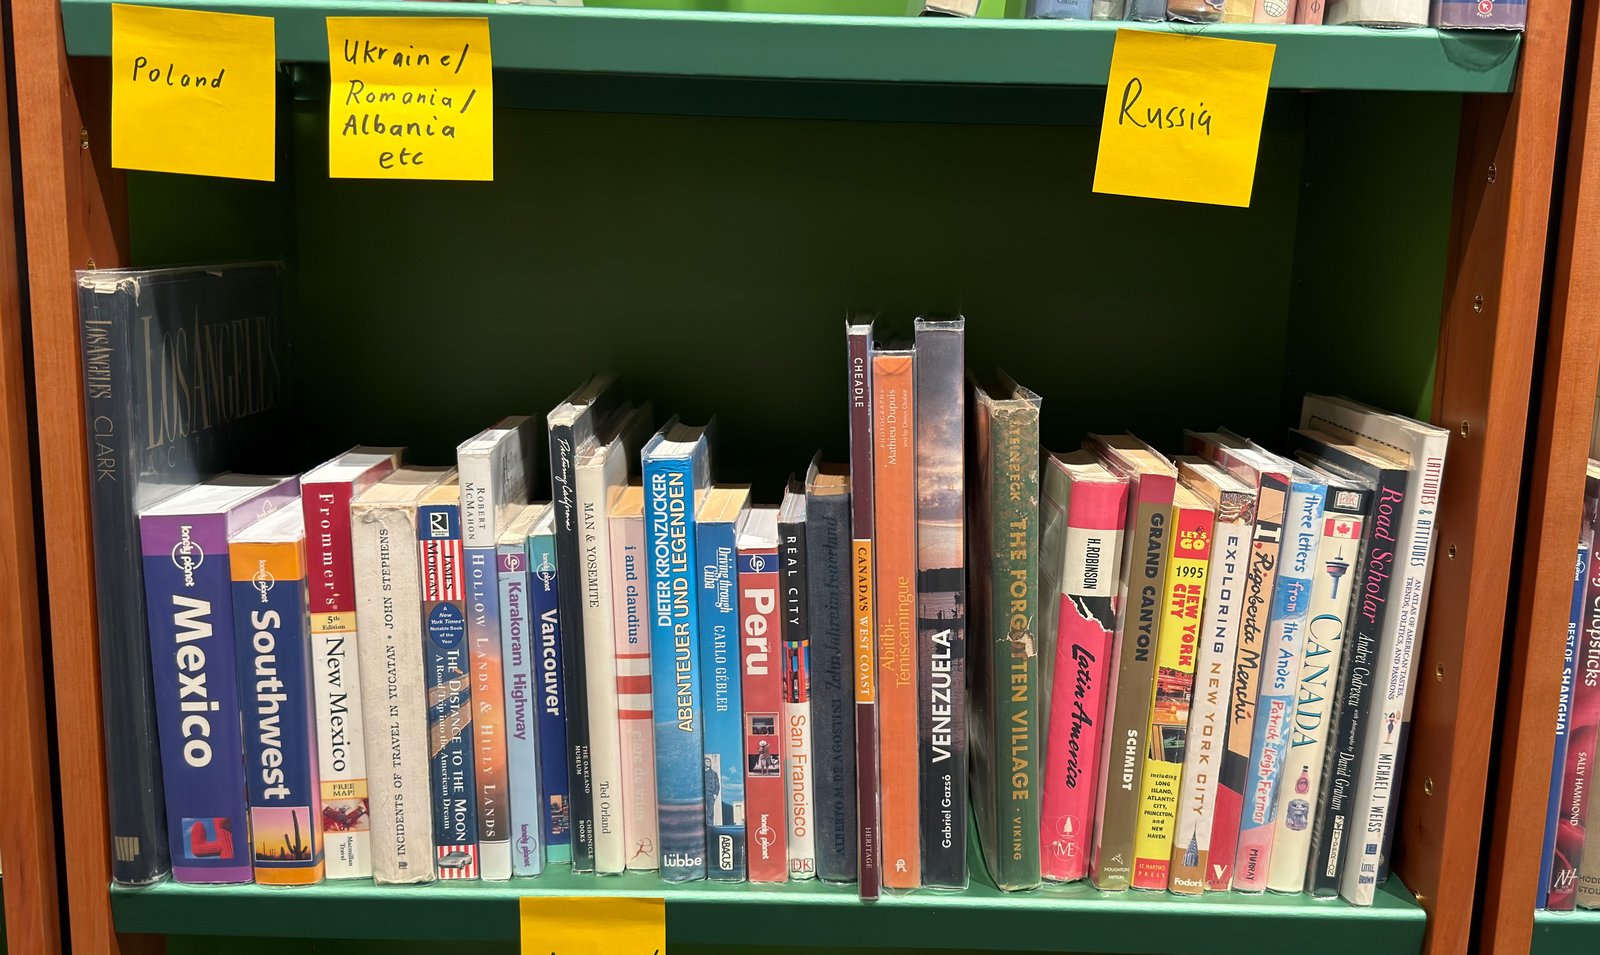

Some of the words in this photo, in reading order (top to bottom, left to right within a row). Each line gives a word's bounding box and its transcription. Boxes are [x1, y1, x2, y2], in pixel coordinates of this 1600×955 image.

[132, 56, 226, 89] Poland
[343, 37, 470, 74] Ukraine/
[344, 80, 476, 114] Romania/
[1118, 76, 1213, 136] Russia
[341, 115, 457, 139] Albania
[378, 147, 425, 170] etc
[853, 357, 864, 408] CHEADLE
[886, 388, 898, 423] Dupuis
[94, 415, 116, 482] CLARK
[886, 426, 897, 465] Mathieu
[1421, 457, 1443, 507] LATITUDES
[477, 487, 486, 530] ROBERT
[584, 502, 595, 531] MAN
[651, 472, 671, 578] KRONZUCKER
[668, 471, 688, 573] LEGENDEN
[1300, 494, 1321, 530] three
[1375, 486, 1405, 542] Road
[180, 525, 193, 555] lonely
[319, 492, 342, 609] Frommer's
[585, 533, 595, 543] &
[1009, 518, 1027, 561] THE
[1144, 512, 1164, 579] GRAND
[1179, 539, 1206, 551] GO
[1180, 531, 1207, 540] LET'S
[1294, 533, 1314, 573] letters
[1411, 519, 1432, 567] ATTITUDES
[180, 555, 195, 587] planet
[258, 559, 268, 580] lonely
[379, 528, 392, 592] STEPHENS
[427, 541, 439, 598] MORGAN
[444, 555, 455, 591] JAMES
[625, 555, 638, 581] and
[716, 546, 733, 580] Driving
[787, 536, 798, 577] REAL
[1175, 565, 1204, 579] 1995
[258, 581, 269, 603] planet
[472, 554, 486, 627] HOLLOW
[586, 545, 600, 609] YOSEMITE
[704, 565, 718, 589] Cuba
[715, 580, 734, 614] through
[857, 547, 869, 612] CANADA'S
[1213, 535, 1238, 653] EXPLORING
[1286, 581, 1305, 613] from
[1362, 548, 1394, 624] Scholar
[382, 596, 394, 630] JOHN
[626, 584, 639, 645] claudius
[656, 581, 672, 628] DIETER
[671, 577, 690, 619] UND
[788, 587, 799, 625] CITY
[1169, 583, 1184, 619] CITY
[1184, 584, 1202, 620] NEW
[1244, 551, 1274, 644] Rigoberta
[1411, 593, 1420, 615] ATLAS
[322, 624, 346, 632] Edition
[327, 615, 341, 625] 5th
[507, 581, 524, 667] Karakoram
[744, 587, 776, 676] Peru
[858, 616, 869, 651] WEST
[895, 575, 914, 689] Témiscamingue
[1134, 585, 1156, 663] CANYON
[1280, 621, 1299, 642] the
[1565, 622, 1576, 647] BEST
[326, 636, 348, 688] New
[446, 649, 459, 672] THE
[476, 638, 490, 691] LANDS
[541, 608, 560, 717] Vancouver
[713, 625, 727, 664] CARLO
[880, 617, 895, 672] Abitibi-
[1177, 624, 1198, 667] YORK
[1355, 632, 1376, 671] Andrei
[1393, 648, 1402, 665] AND
[1400, 628, 1414, 668] AMERICAN
[1564, 648, 1573, 663] OF
[172, 594, 220, 769] Mexico
[386, 644, 398, 699] YUCATAN
[436, 665, 445, 690] Road
[674, 622, 694, 733] ABENTEUER
[859, 654, 871, 697] COAST
[1071, 643, 1096, 700] Latin
[1203, 662, 1221, 705] NEW
[1234, 647, 1259, 725] Menchú
[1274, 648, 1294, 690] Andes
[1290, 613, 1343, 749] CANADA
[1347, 667, 1370, 707] Codrescu
[1388, 665, 1399, 701] PASSIONS
[250, 610, 292, 800] Southwest
[480, 701, 493, 714] &
[512, 673, 528, 741] Highway
[715, 668, 728, 712] GÉBLER
[931, 628, 952, 764] VENEZUELA
[1555, 667, 1573, 736] SHANGHAI
[389, 705, 399, 717] IN
[447, 680, 463, 744] DISTANCE
[1266, 700, 1285, 741] Patrick
[329, 691, 351, 772] Mexico
[388, 721, 402, 768] TRAVEL
[480, 725, 494, 775] HILLY
[790, 714, 806, 749] San
[1066, 700, 1093, 789] America
[1198, 712, 1215, 765] YORK
[440, 752, 449, 790] American
[450, 748, 463, 767] TO
[1011, 709, 1029, 801] VILLAGE
[1122, 729, 1138, 791] SCHMIDT
[1259, 747, 1277, 778] Leigh
[1336, 751, 1355, 778] David
[1374, 753, 1393, 791] MICHAEL
[1577, 751, 1588, 778] SALLY
[332, 783, 355, 791] FREE
[332, 790, 356, 798] MAP!
[393, 775, 403, 789] OF
[452, 770, 465, 793] THE
[599, 781, 609, 799] Ted
[791, 753, 809, 838] Francisco
[941, 774, 952, 808] Gazsó
[1149, 772, 1177, 781] including
[1150, 787, 1173, 796] ISLAND,
[1192, 773, 1207, 817] CITY
[1330, 778, 1350, 811] Graham
[442, 792, 451, 830] Dream
[483, 784, 496, 839] LANDS
[600, 802, 611, 835] Orland
[1146, 795, 1176, 803] ATLANTIC
[1570, 778, 1584, 826] HAMMOND
[394, 793, 406, 857] INCIDENTS
[453, 799, 467, 841] MOON
[578, 820, 586, 843] BOOKS
[941, 810, 952, 849] Gabriel
[1013, 816, 1022, 861] VIKING
[1367, 806, 1385, 833] WEISS
[586, 819, 594, 861] CHRONICLE
[720, 835, 732, 870] ABACUS
[865, 826, 873, 869] HERITAGE
[1326, 830, 1341, 876] HYPERION
[1173, 877, 1203, 888] Fodor's
[1244, 848, 1258, 881] MURRAY
